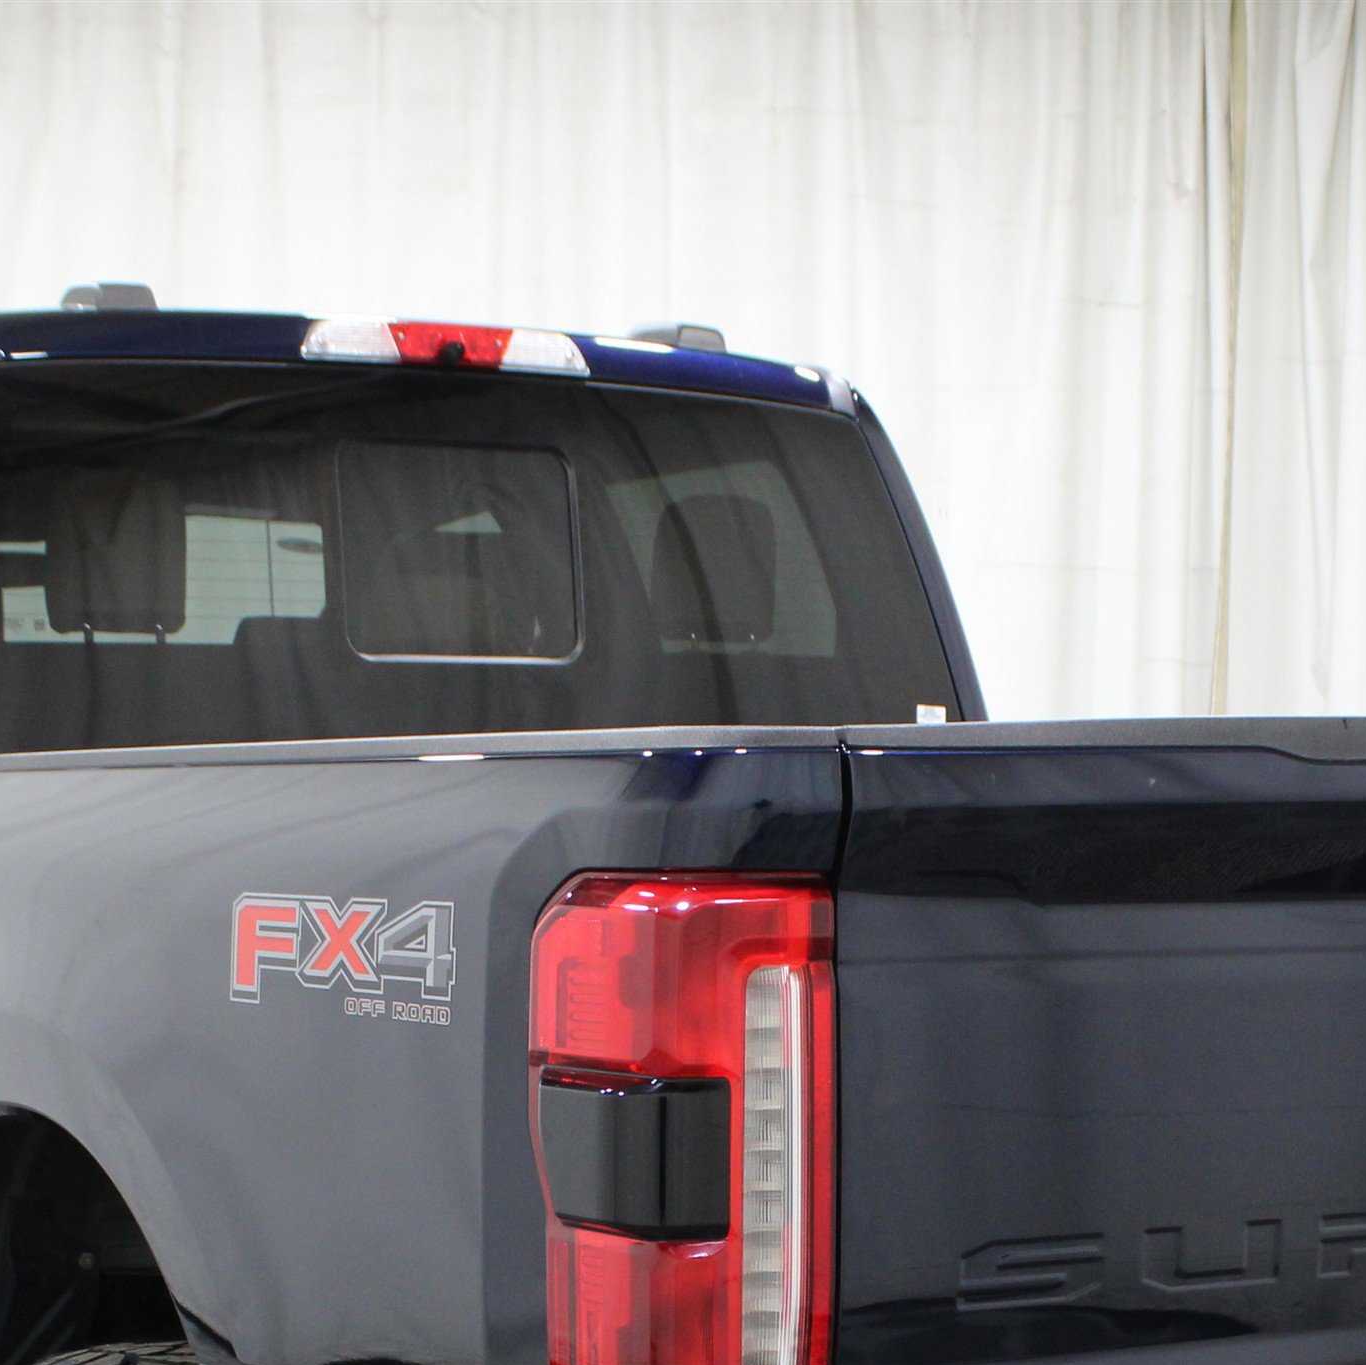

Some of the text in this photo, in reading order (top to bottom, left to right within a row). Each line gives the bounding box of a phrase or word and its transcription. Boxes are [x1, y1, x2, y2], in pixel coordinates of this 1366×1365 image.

[230, 892, 456, 1003] FX4
[344, 997, 451, 1025] OFF ROAD
